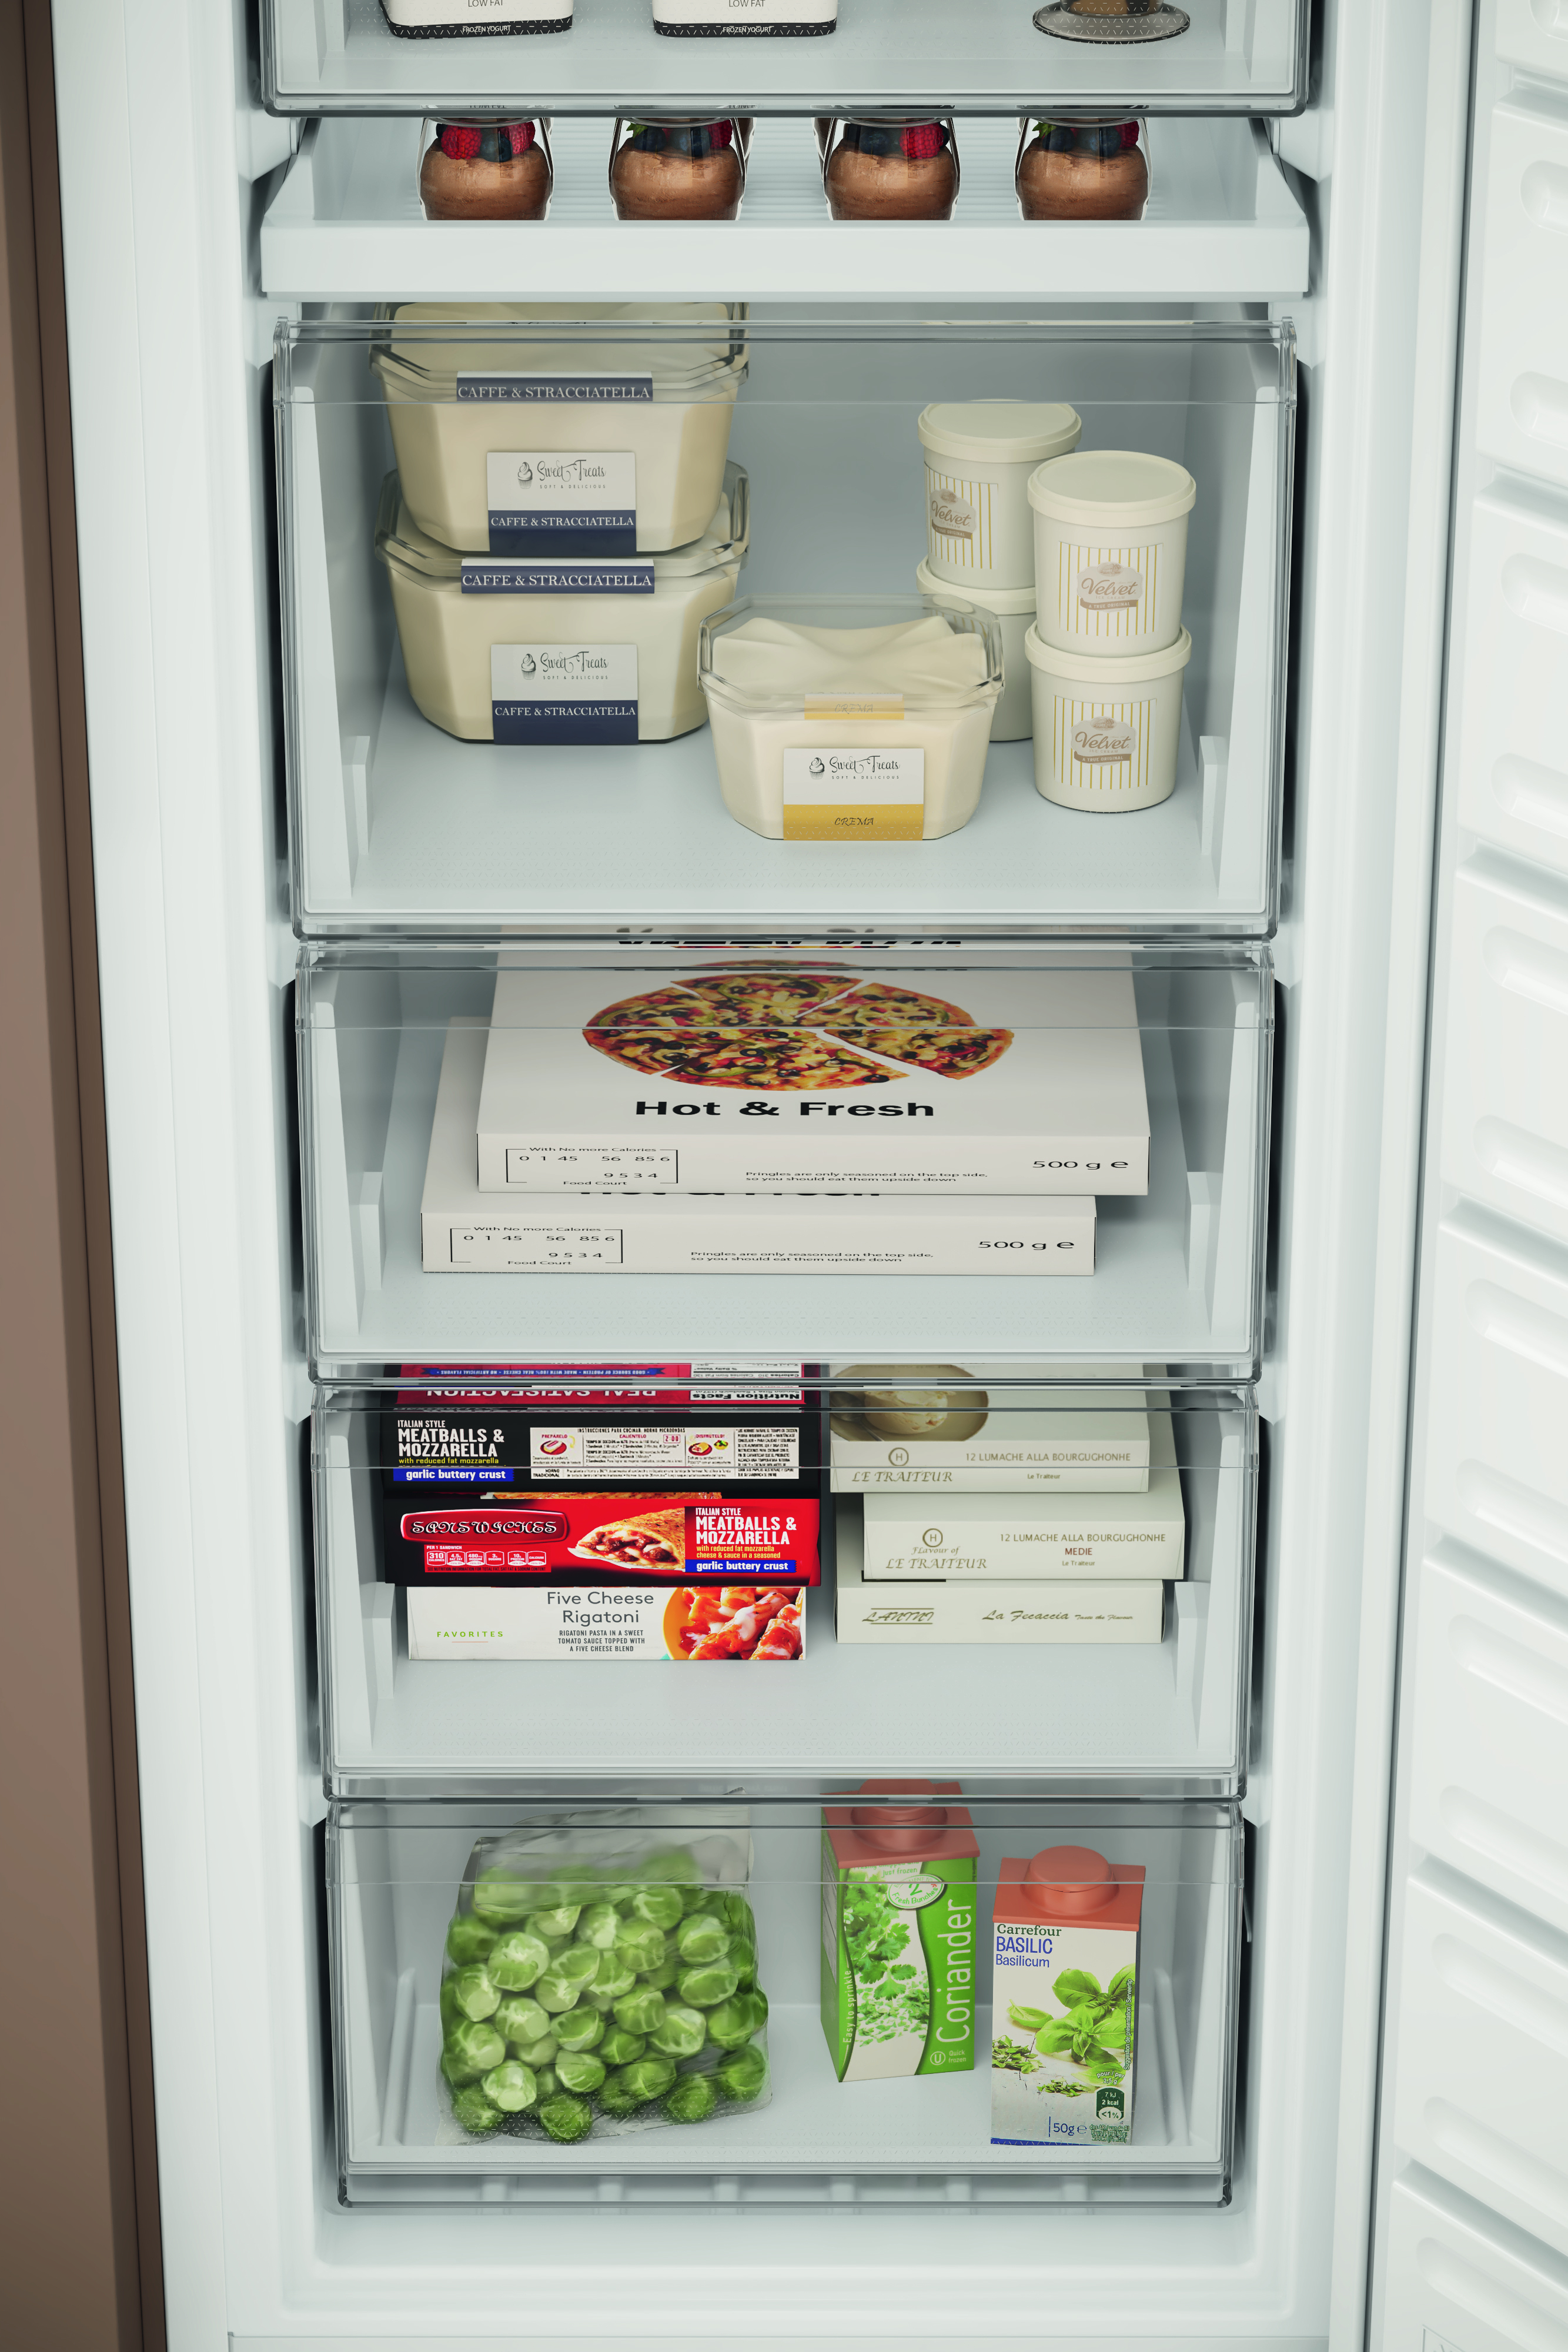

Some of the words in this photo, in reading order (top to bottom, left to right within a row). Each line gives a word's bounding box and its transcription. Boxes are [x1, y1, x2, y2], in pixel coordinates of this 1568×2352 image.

[458, 387, 507, 398] CAFFE
[511, 387, 522, 398] &
[526, 387, 650, 398] STRACCIATELLA
[537, 460, 571, 482] Sweet
[573, 459, 606, 481] Treats
[931, 500, 971, 526] Velvet
[491, 517, 527, 526] CAFFE
[531, 517, 539, 526] &
[541, 517, 634, 526] STRACCIATELLA
[462, 575, 511, 586] CAFFE
[515, 575, 526, 586] &
[529, 575, 652, 586] STRACCIATELLA
[1081, 577, 1138, 595] Velvet
[494, 707, 531, 716] CAFFE
[534, 707, 542, 716] &
[544, 707, 636, 716] STRACCIATELLA
[1075, 731, 1132, 749] Velvet
[829, 756, 866, 774] Sweet
[867, 755, 901, 773] Treats
[834, 817, 874, 826] CREMA
[636, 1101, 721, 1116] Hot
[739, 1101, 780, 1117] &
[800, 1101, 934, 1117] Fresh
[397, 1419, 423, 1428] ITALIAN
[425, 1419, 446, 1428] STYLE
[398, 1428, 487, 1442] MEATBALLS
[493, 1429, 504, 1442] &
[399, 1443, 498, 1457] MOZZARELLA
[965, 1453, 976, 1461] 12
[979, 1453, 1024, 1461] LUMACHE
[1026, 1453, 1049, 1461] ALLA
[1052, 1453, 1131, 1461] BOURGUGHONHE
[406, 1469, 435, 1481] garlic
[438, 1469, 476, 1481] buttery
[479, 1471, 506, 1479] crust
[851, 1471, 871, 1482] LE
[874, 1471, 953, 1482] TRAITEUR
[696, 1507, 720, 1516] ITALIAN
[721, 1508, 741, 1516] STYLE
[696, 1516, 781, 1531] MEATBALLS
[785, 1516, 797, 1531] &
[696, 1531, 790, 1545] MOZZARELLA
[1000, 1534, 1010, 1542] 12
[1013, 1534, 1058, 1542] LUMACHE
[1061, 1534, 1084, 1542] ALLA
[1087, 1534, 1166, 1542] BOURGUGHONHE
[696, 1561, 724, 1572] garlic
[726, 1561, 761, 1572] buttery
[885, 1558, 904, 1569] LE
[908, 1558, 988, 1569] TRAITEUR
[547, 1592, 581, 1605] Five
[587, 1591, 654, 1605] Cheese
[563, 1610, 639, 1627] Rigatoni
[982, 1609, 1005, 1621] La
[881, 1869, 895, 1878] just
[892, 1892, 910, 1905] Fresh
[911, 1887, 938, 1905] Bunches
[997, 1923, 1062, 1936] Carrefour
[996, 1936, 1053, 1955] BASILIC
[996, 1953, 1050, 1968] Basilicum
[936, 1899, 972, 2043] Coriander
[844, 1970, 856, 2008] sprinkle
[1125, 1979, 1134, 2003] Serveertip
[845, 2011, 854, 2020] to
[1124, 2006, 1132, 2036] présentation
[842, 2023, 855, 2043] Easy
[1124, 2044, 1132, 2070] Suggestion
[1053, 2123, 1075, 2136] 50g
